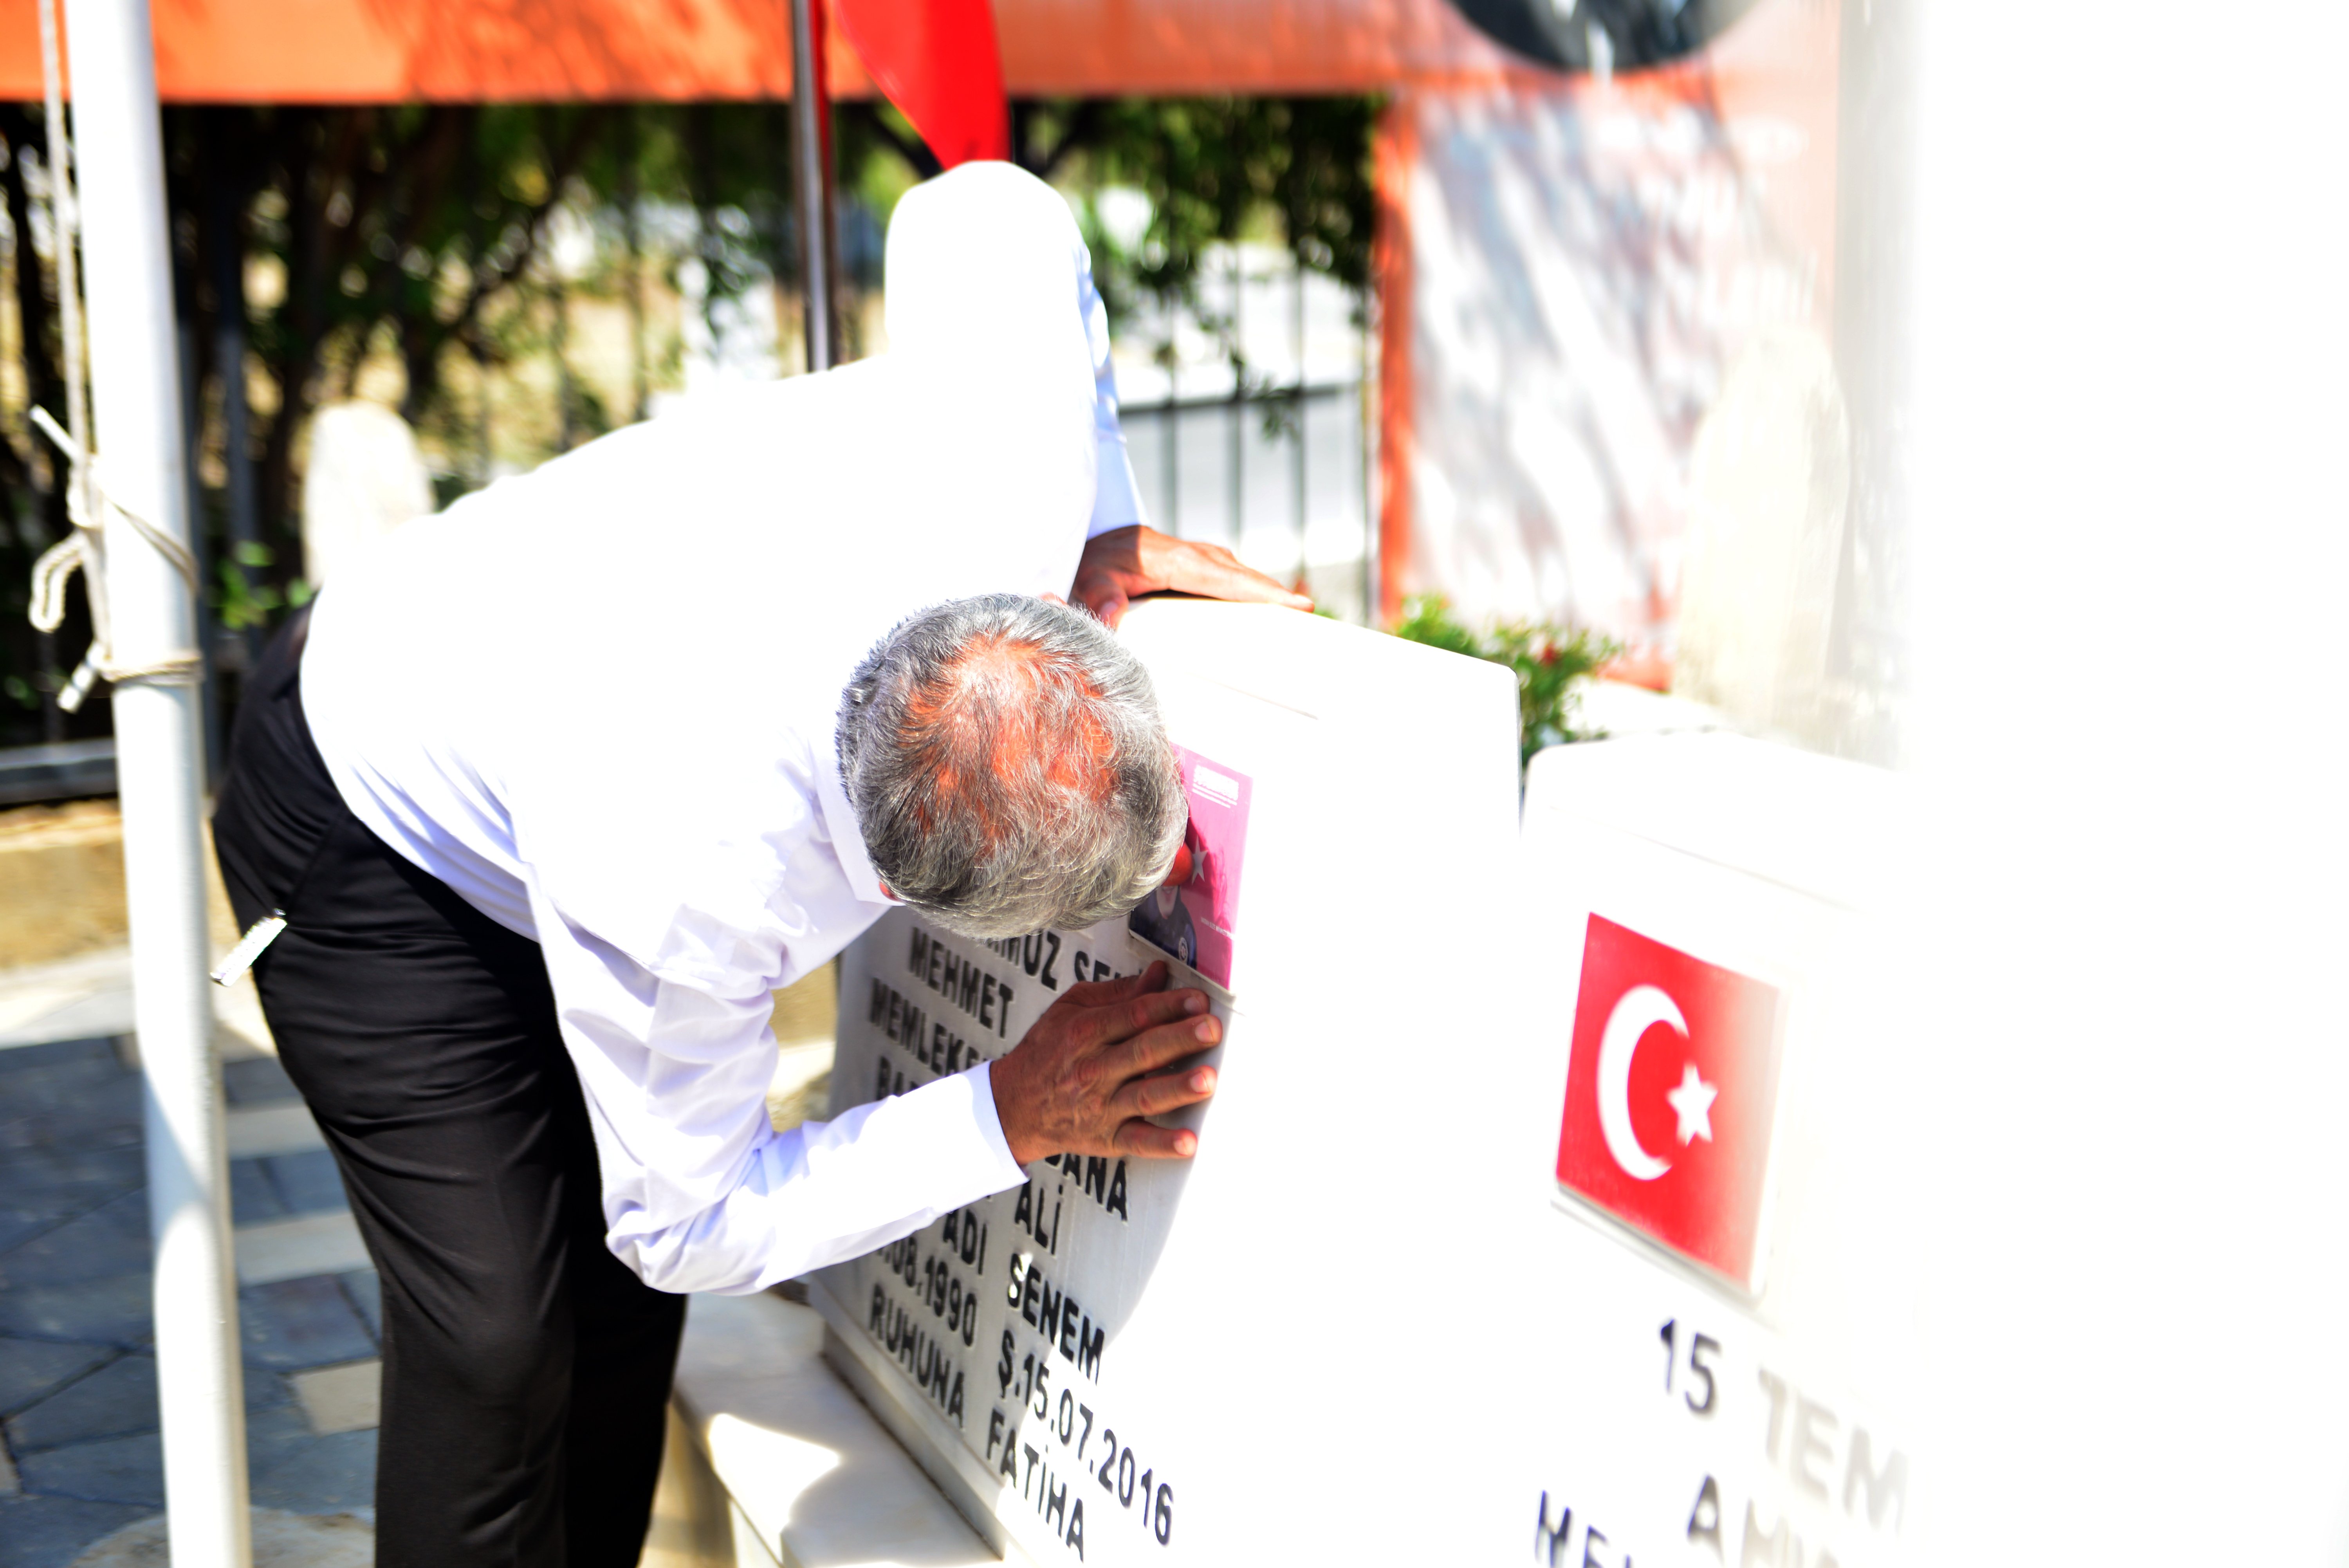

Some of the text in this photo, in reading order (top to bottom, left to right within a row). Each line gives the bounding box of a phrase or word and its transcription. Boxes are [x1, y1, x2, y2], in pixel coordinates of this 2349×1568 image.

[909, 926, 1014, 1040] MEHMET
[1007, 1253, 1105, 1386] SENEM
[870, 1283, 1084, 1563] RUHUNA FATİHA
[1659, 1317, 1909, 1535] 15 TEM
